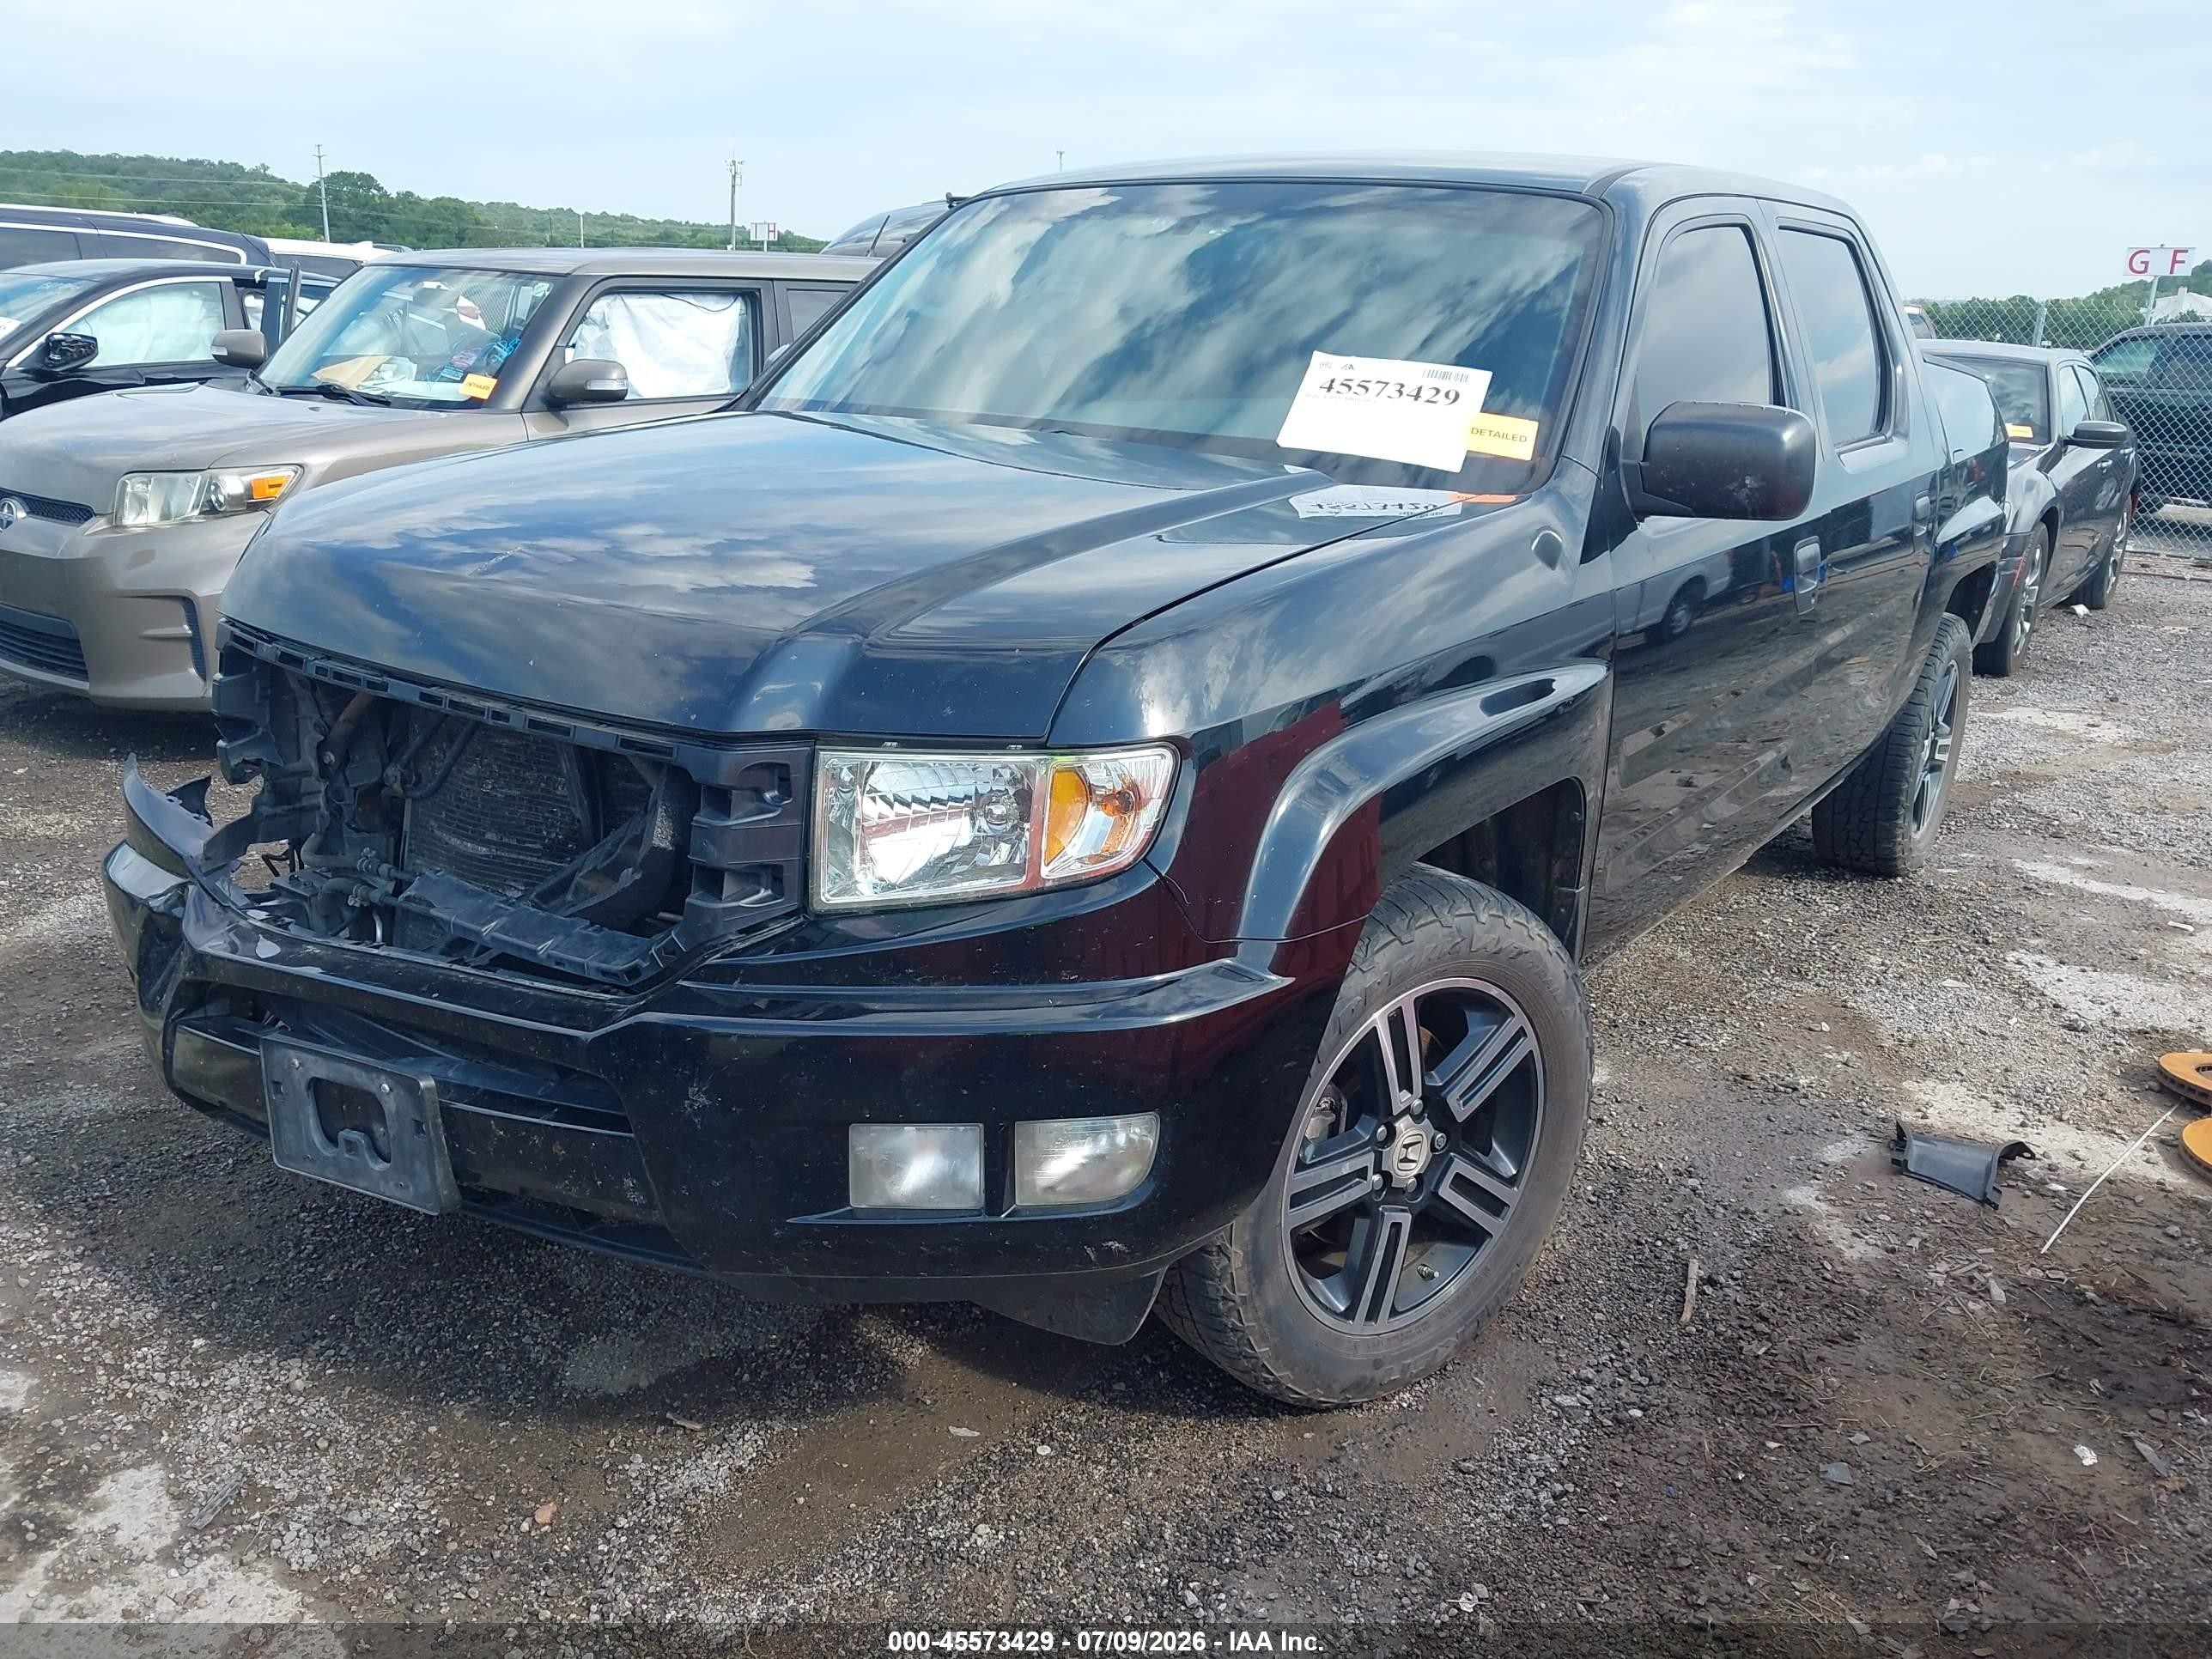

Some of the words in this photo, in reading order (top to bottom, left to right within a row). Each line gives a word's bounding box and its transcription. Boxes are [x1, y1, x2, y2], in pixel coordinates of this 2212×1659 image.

[767, 222, 776, 240] H
[2128, 249, 2150, 274] G
[2169, 249, 2189, 275] F
[1319, 378, 1460, 405] 45573429
[1470, 427, 1528, 442] DETAILED
